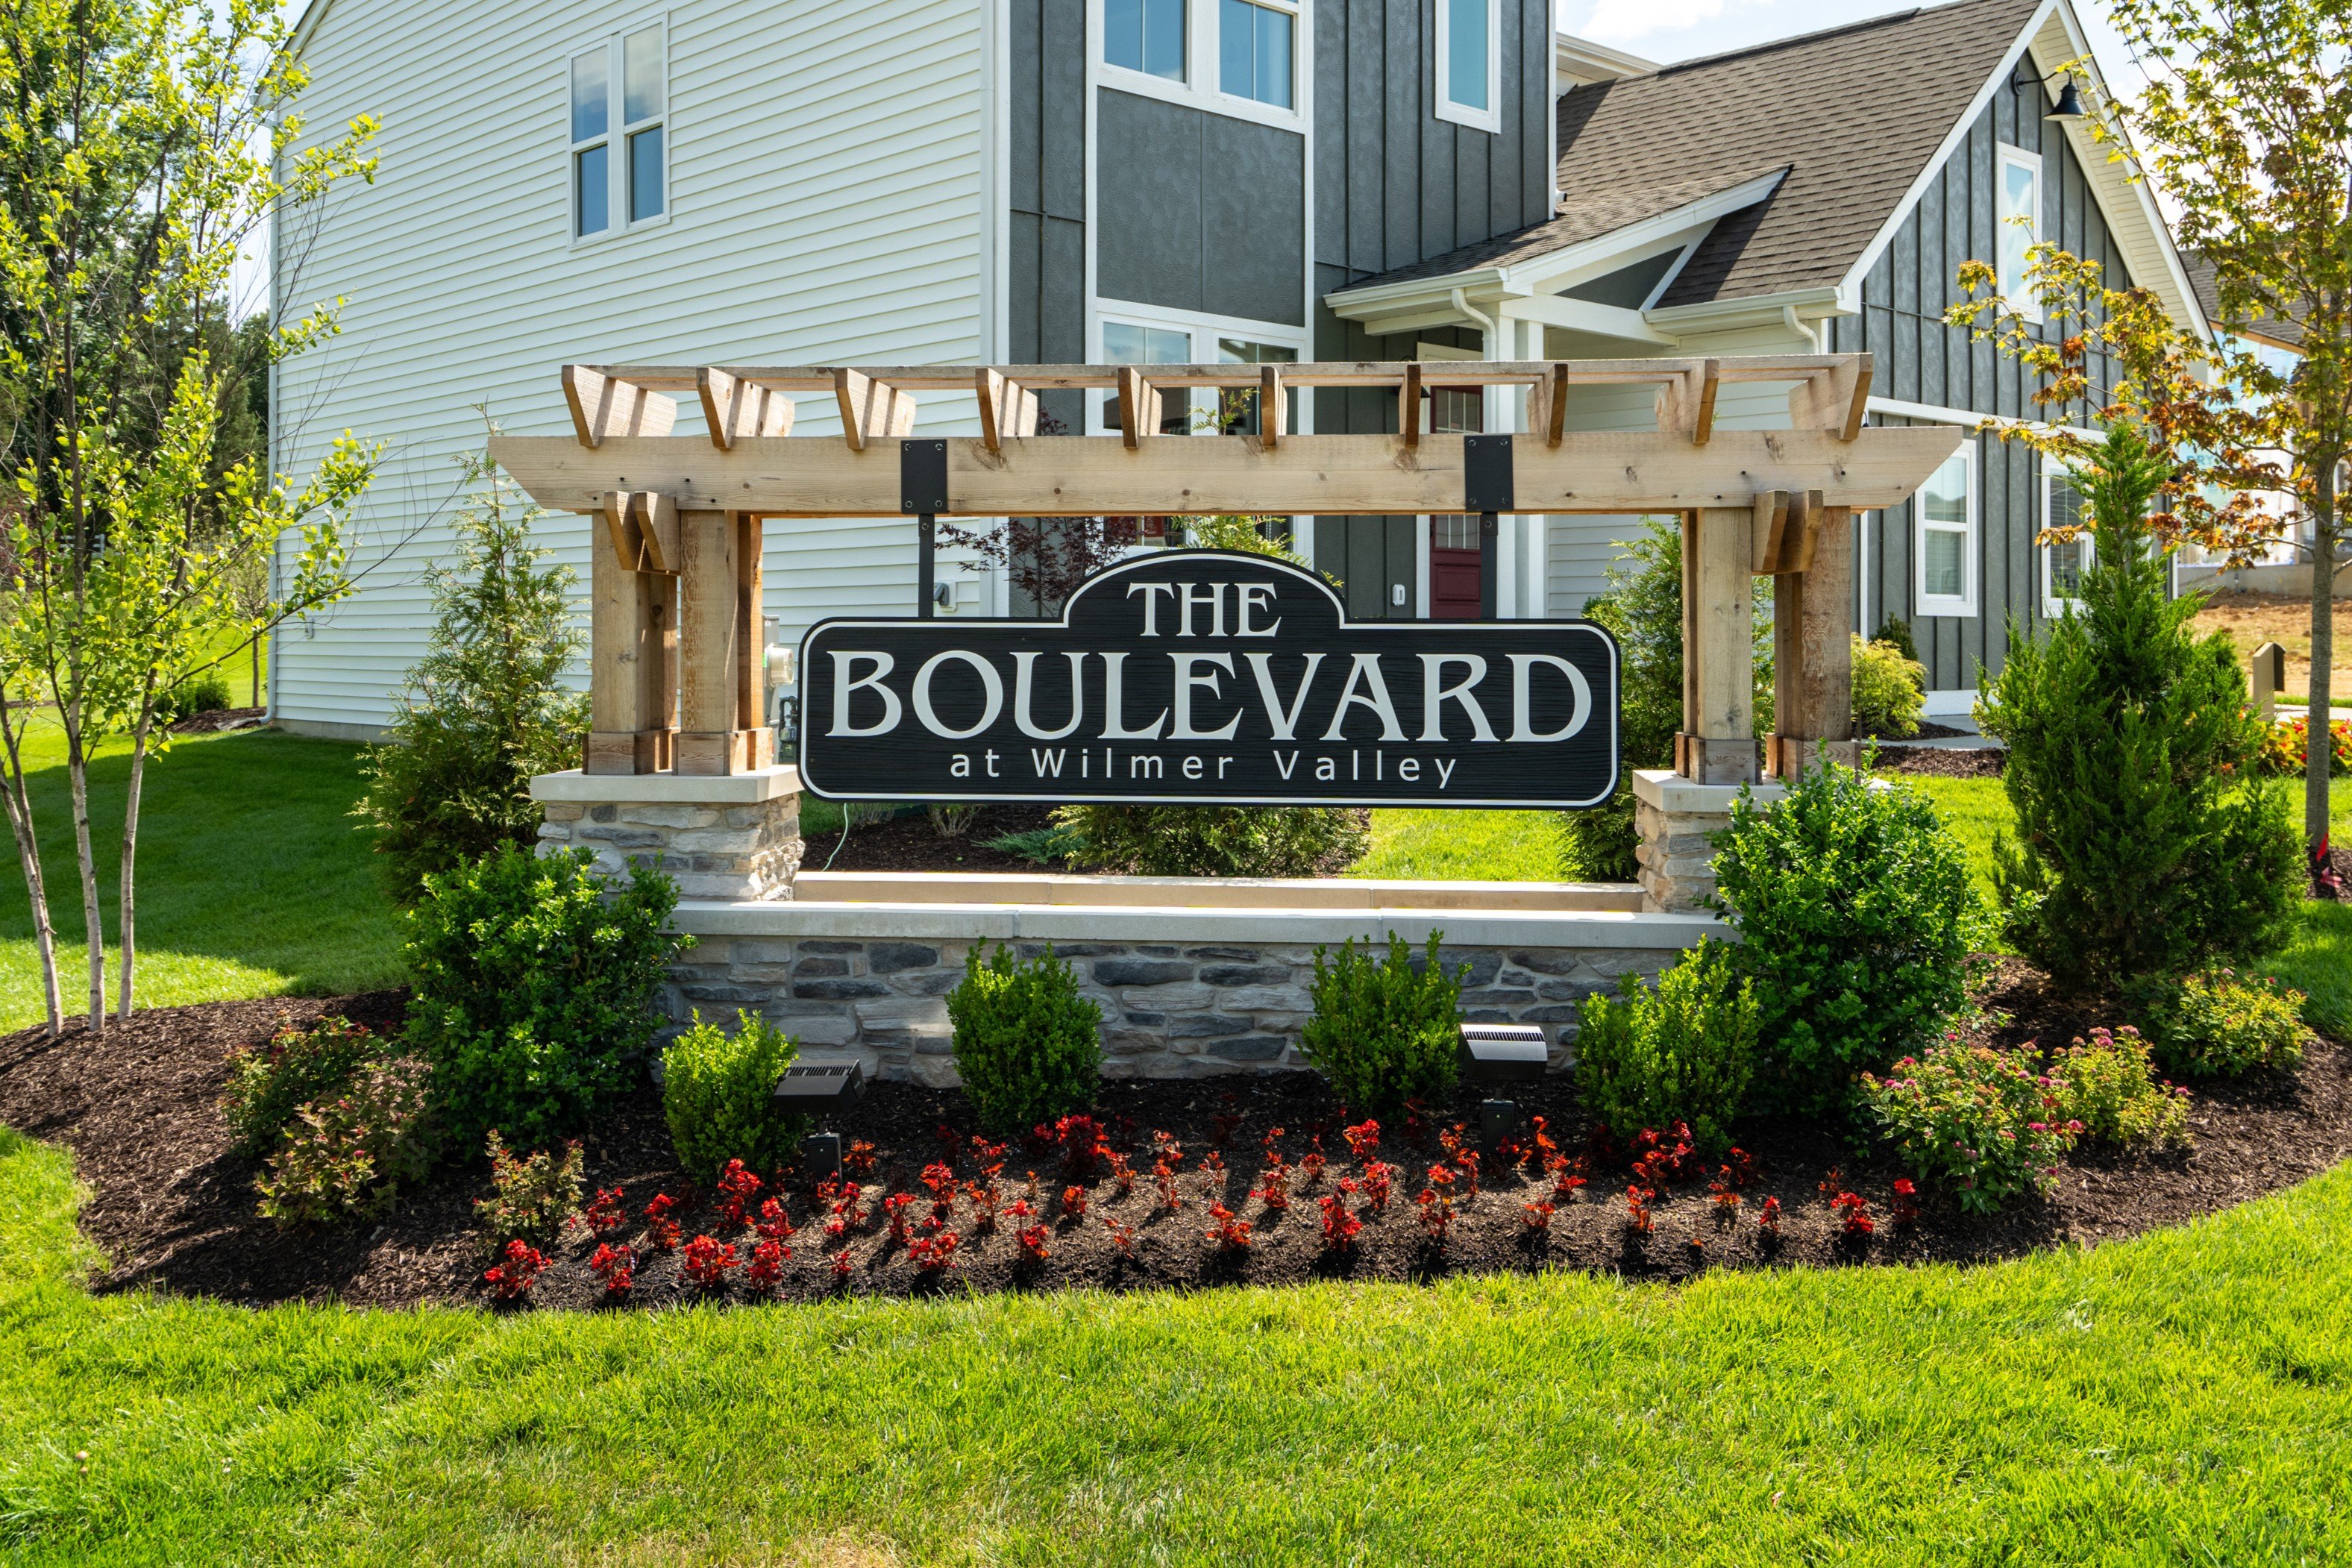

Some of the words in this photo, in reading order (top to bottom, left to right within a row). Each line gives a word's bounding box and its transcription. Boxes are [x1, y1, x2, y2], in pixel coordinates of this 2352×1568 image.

[1127, 583, 1282, 637] THE
[824, 650, 1592, 742] BOULEVARD
[950, 749, 1000, 777] at
[1031, 748, 1233, 779] Wilmer
[1273, 750, 1456, 789] Valley
